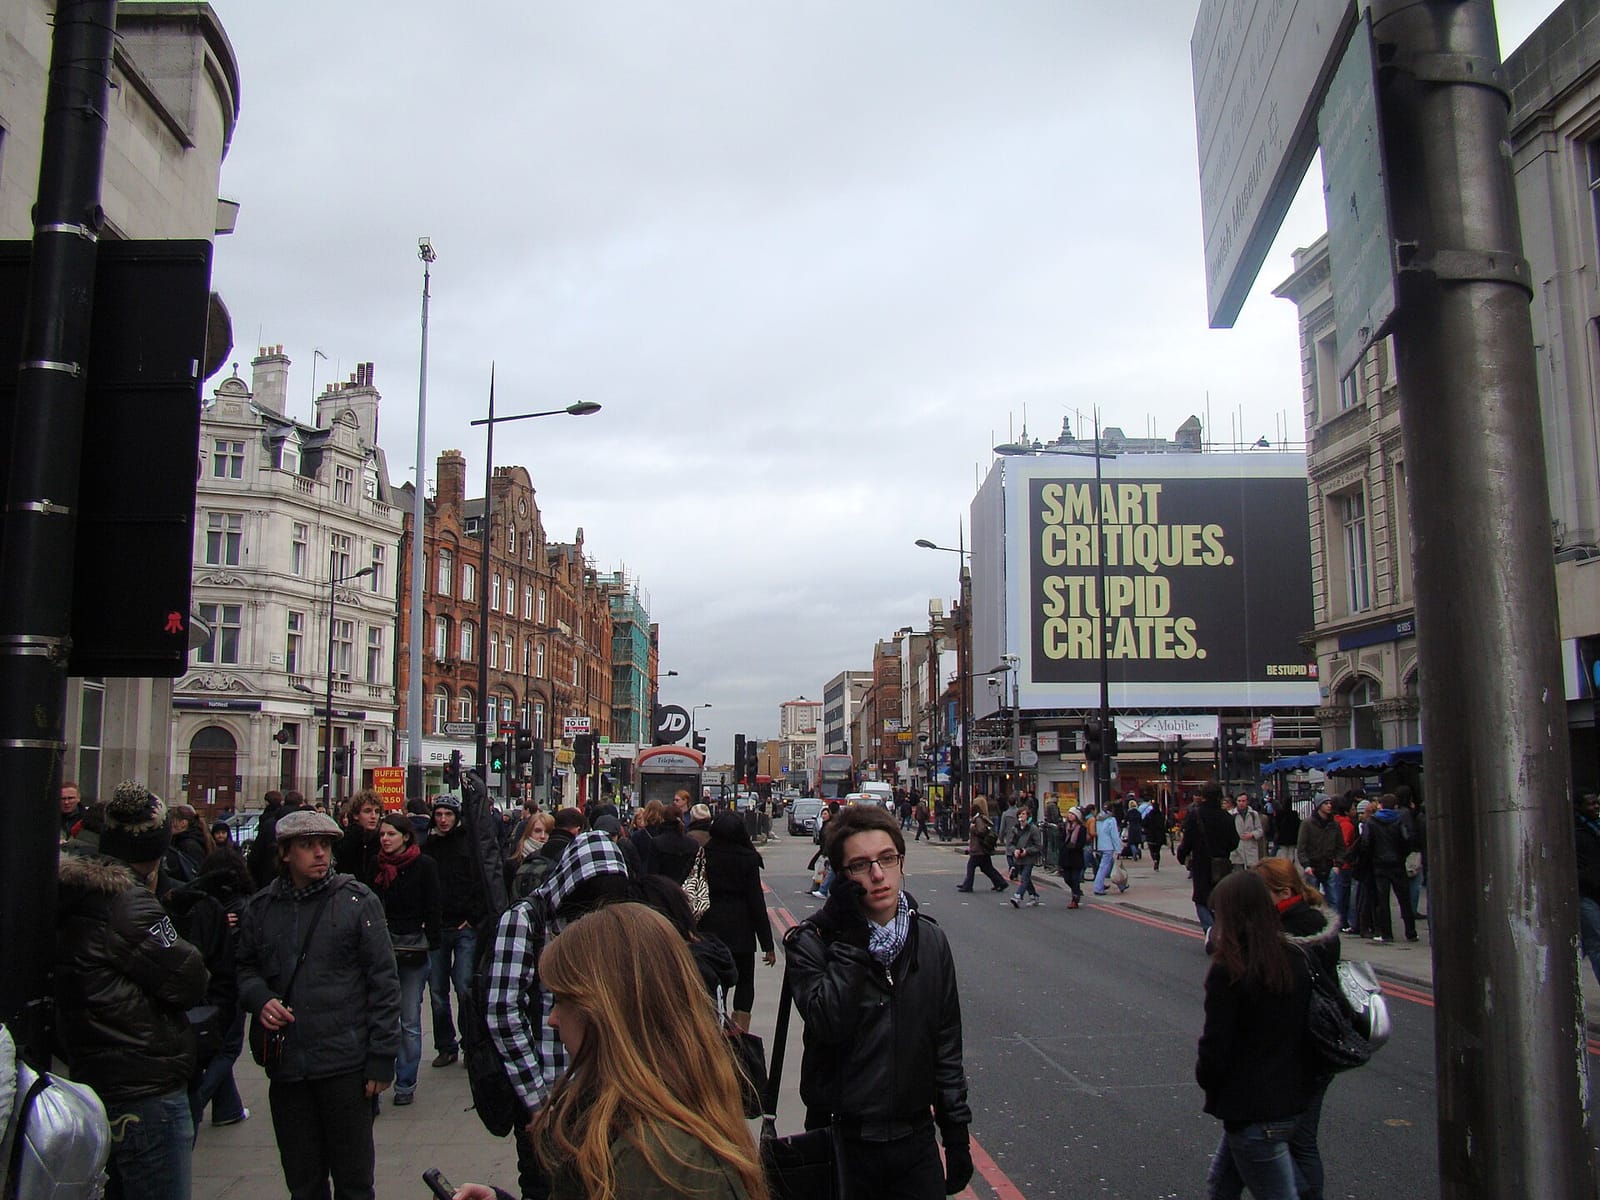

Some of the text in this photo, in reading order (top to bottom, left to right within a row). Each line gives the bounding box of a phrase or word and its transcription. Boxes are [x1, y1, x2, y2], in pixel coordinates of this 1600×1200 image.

[1208, 140, 1267, 288] Jewish Museum
[1041, 483, 1162, 525] SMART
[1041, 524, 1234, 573] CRITIQUES.
[1042, 575, 1171, 617] STUPID
[1043, 617, 1207, 660] CREATES.
[1266, 665, 1277, 676] BE
[1278, 665, 1307, 676] STUPID
[658, 713, 686, 732] JD
[374, 784, 404, 794] takeout
[149, 915, 178, 948] 75
